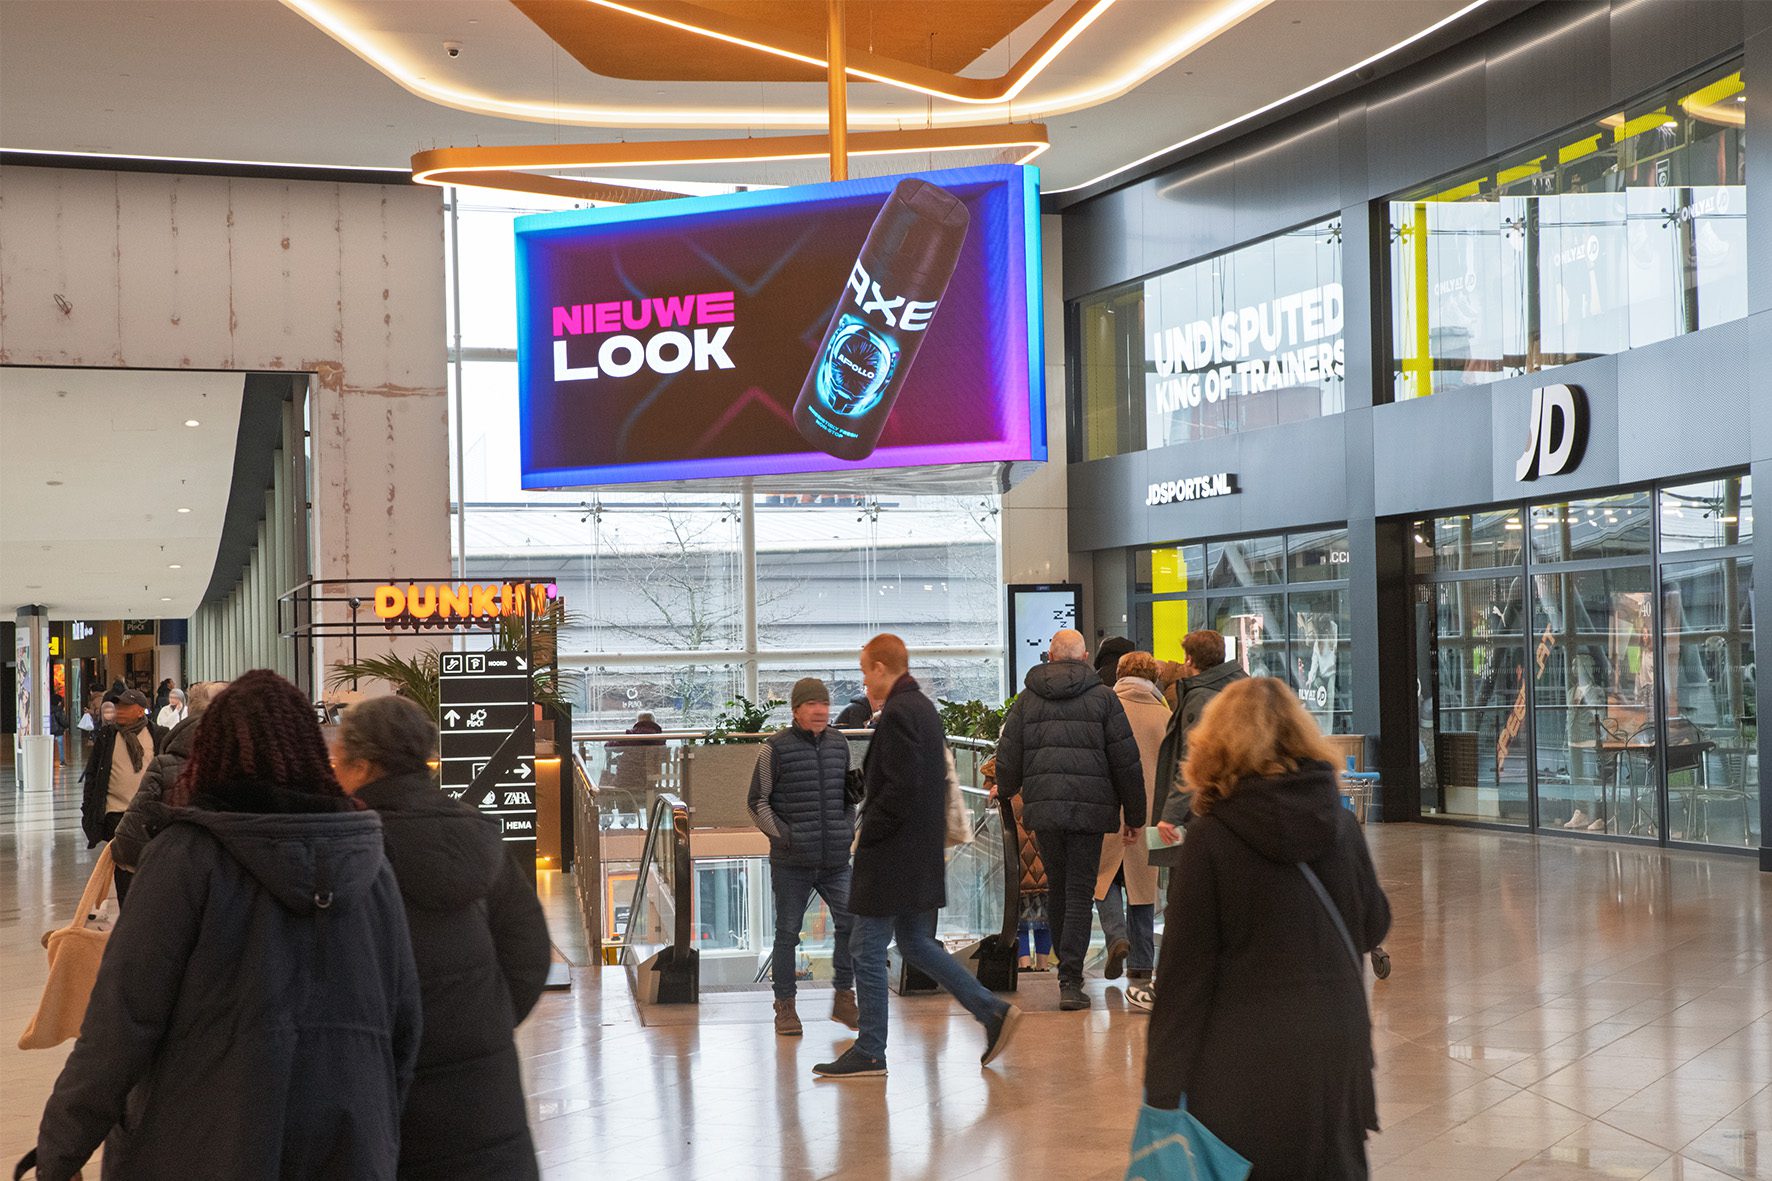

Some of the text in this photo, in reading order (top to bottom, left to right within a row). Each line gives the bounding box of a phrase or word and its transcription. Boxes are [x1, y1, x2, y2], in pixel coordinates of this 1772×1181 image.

[552, 291, 735, 336] NIEUWE
[847, 257, 938, 332] AXE
[553, 326, 736, 382] LOOK
[1153, 282, 1344, 378] UNDISPUTED
[838, 354, 874, 379] APOLLO
[1154, 338, 1345, 415] KING OF TRAINERS
[1515, 383, 1576, 482] JD
[1145, 472, 1232, 506] JDSPORTS.NL
[503, 791, 533, 805] ZARA
[506, 820, 533, 830] HEMA
